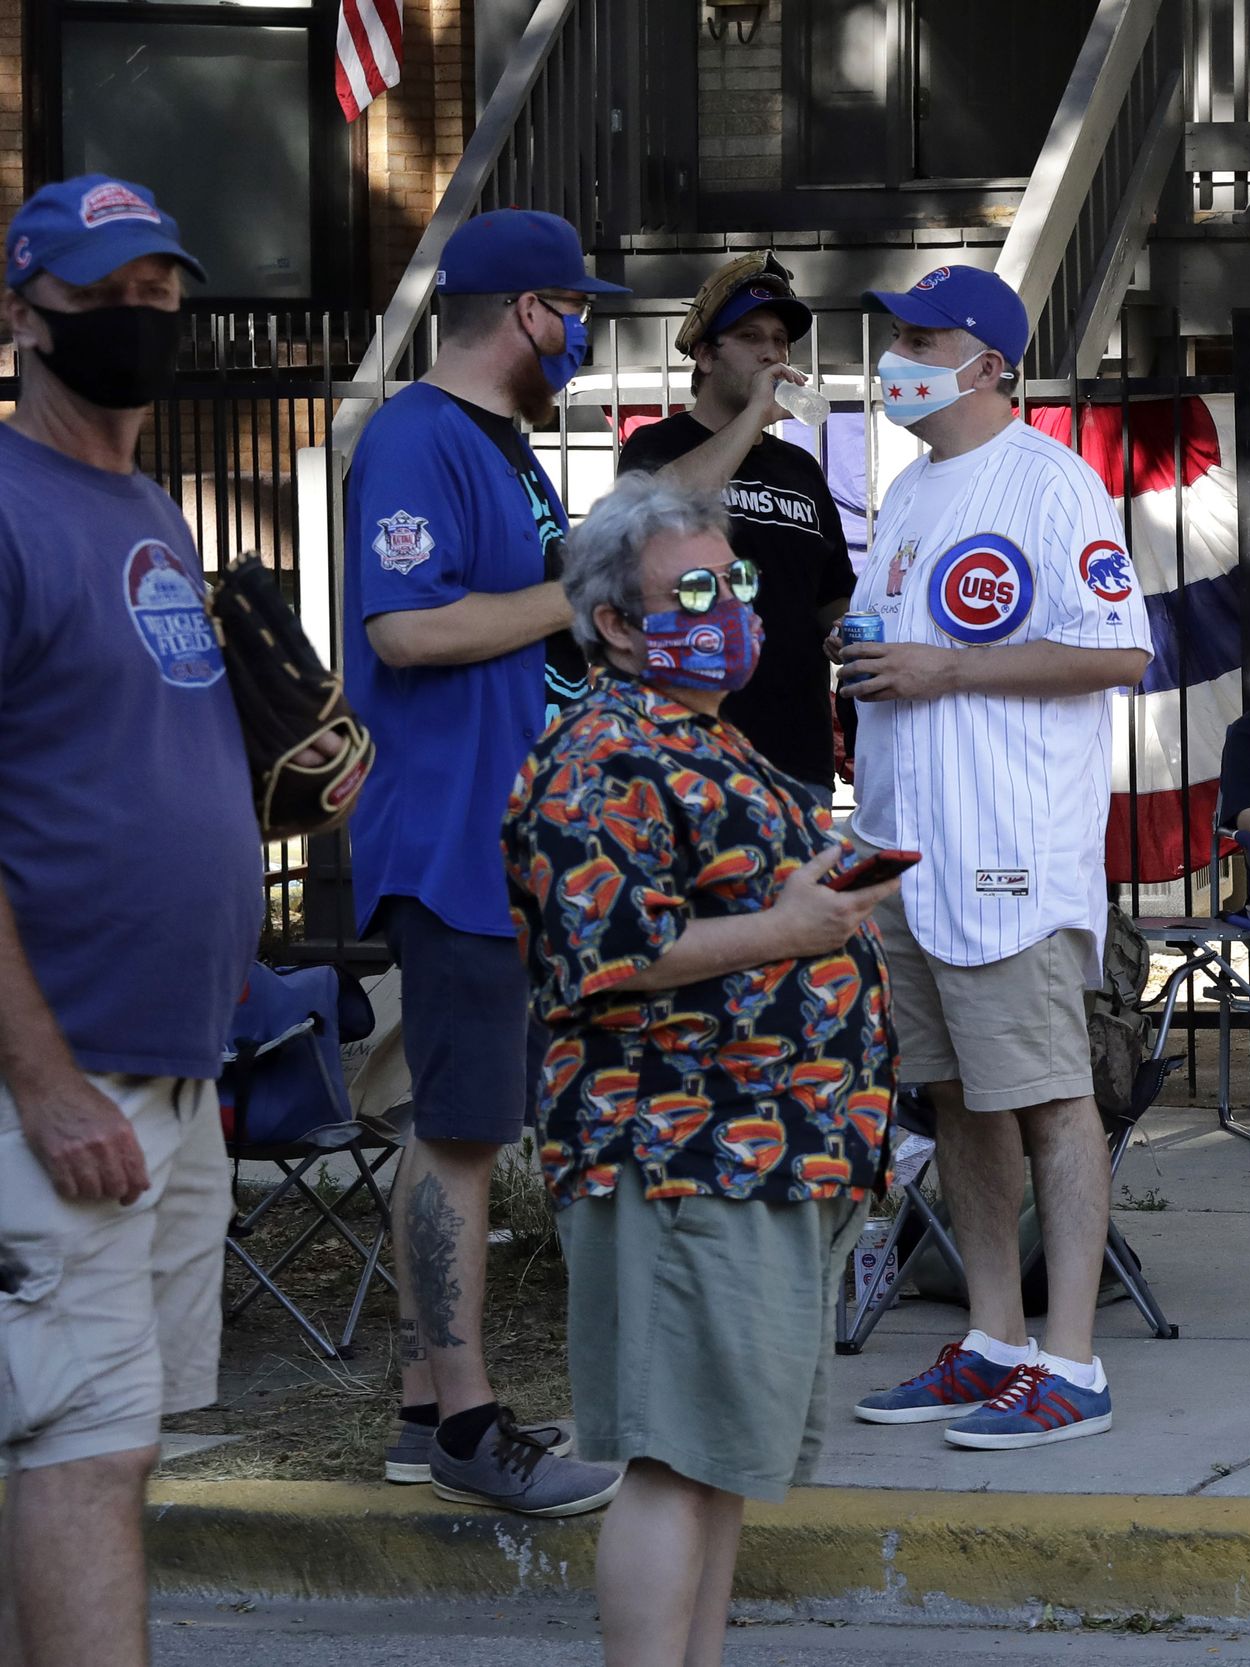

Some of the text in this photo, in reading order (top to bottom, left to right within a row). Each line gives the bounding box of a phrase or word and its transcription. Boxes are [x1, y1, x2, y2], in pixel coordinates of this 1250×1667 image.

[773, 496, 814, 523] WAY
[944, 551, 1016, 626] CUBS
[142, 611, 210, 636] WRIGLE
